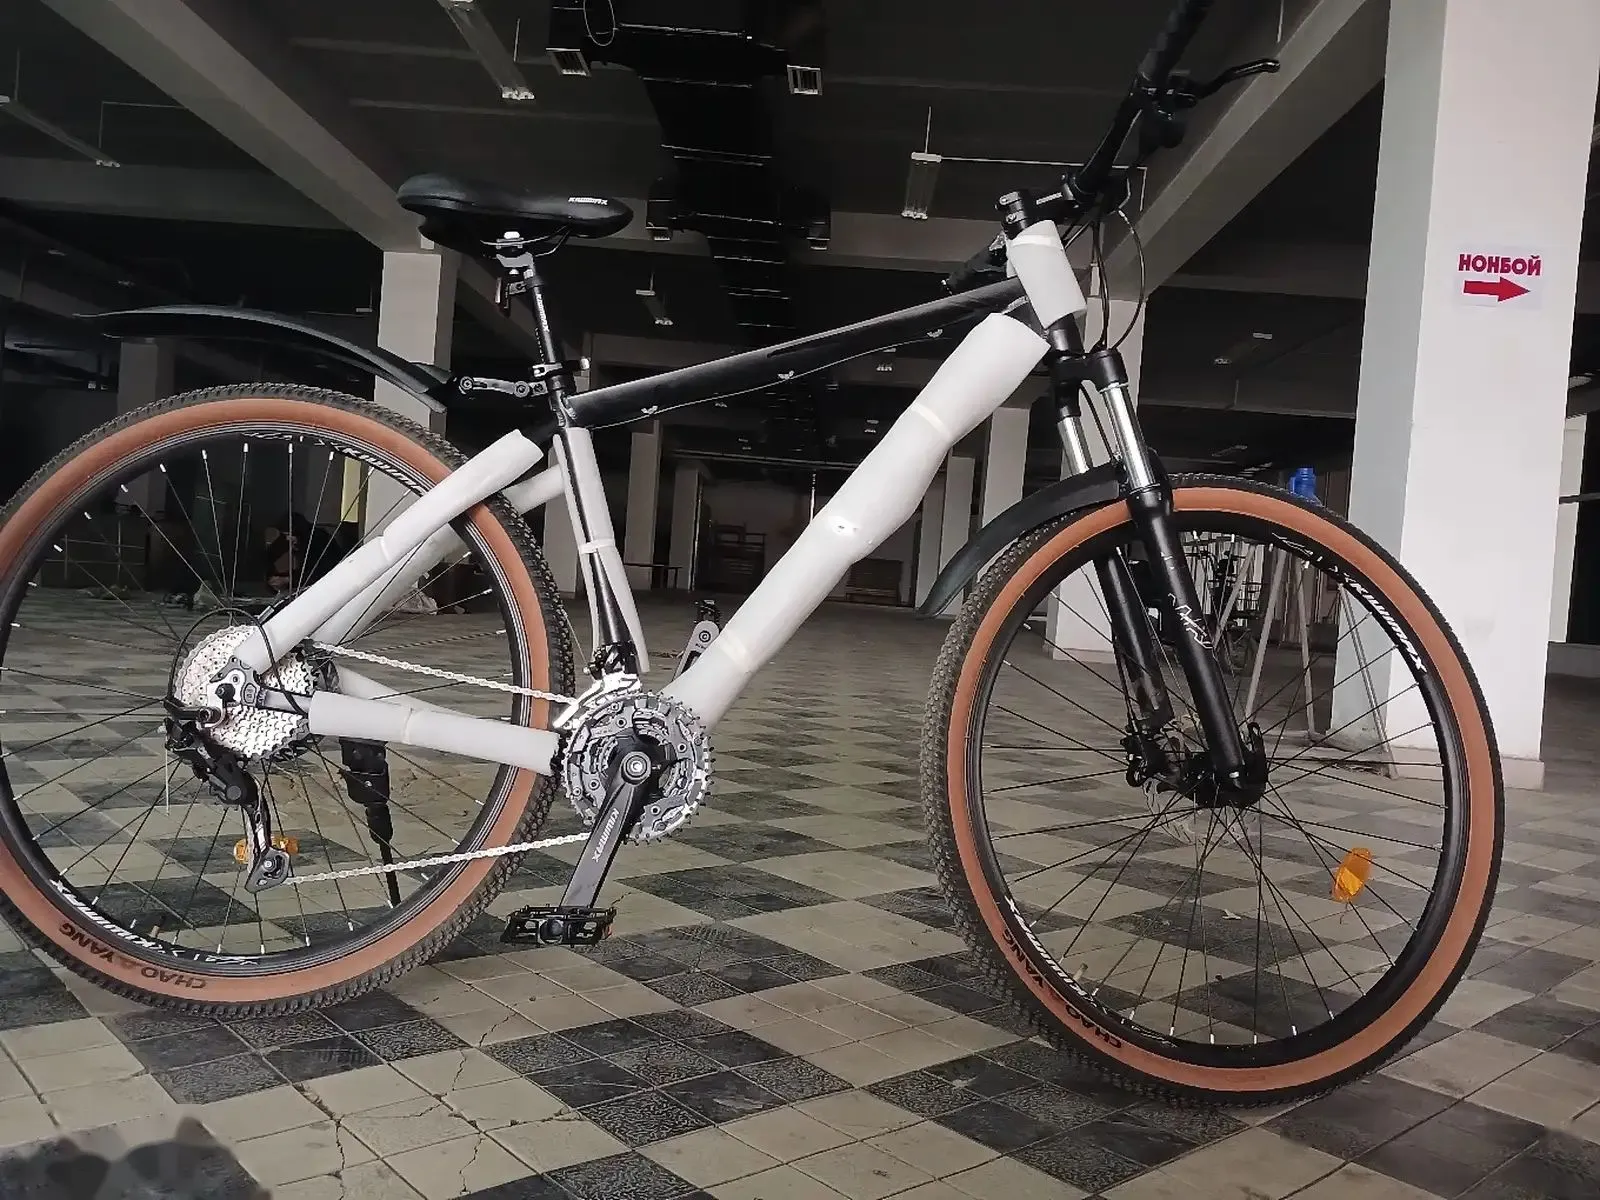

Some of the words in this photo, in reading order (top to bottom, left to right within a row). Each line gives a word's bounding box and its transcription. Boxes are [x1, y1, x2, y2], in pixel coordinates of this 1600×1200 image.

[1458, 253, 1541, 276] НОНБОЙ
[59, 922, 114, 963] YANG
[140, 965, 207, 989] CHAO
[1065, 1004, 1122, 1049] CHAO
